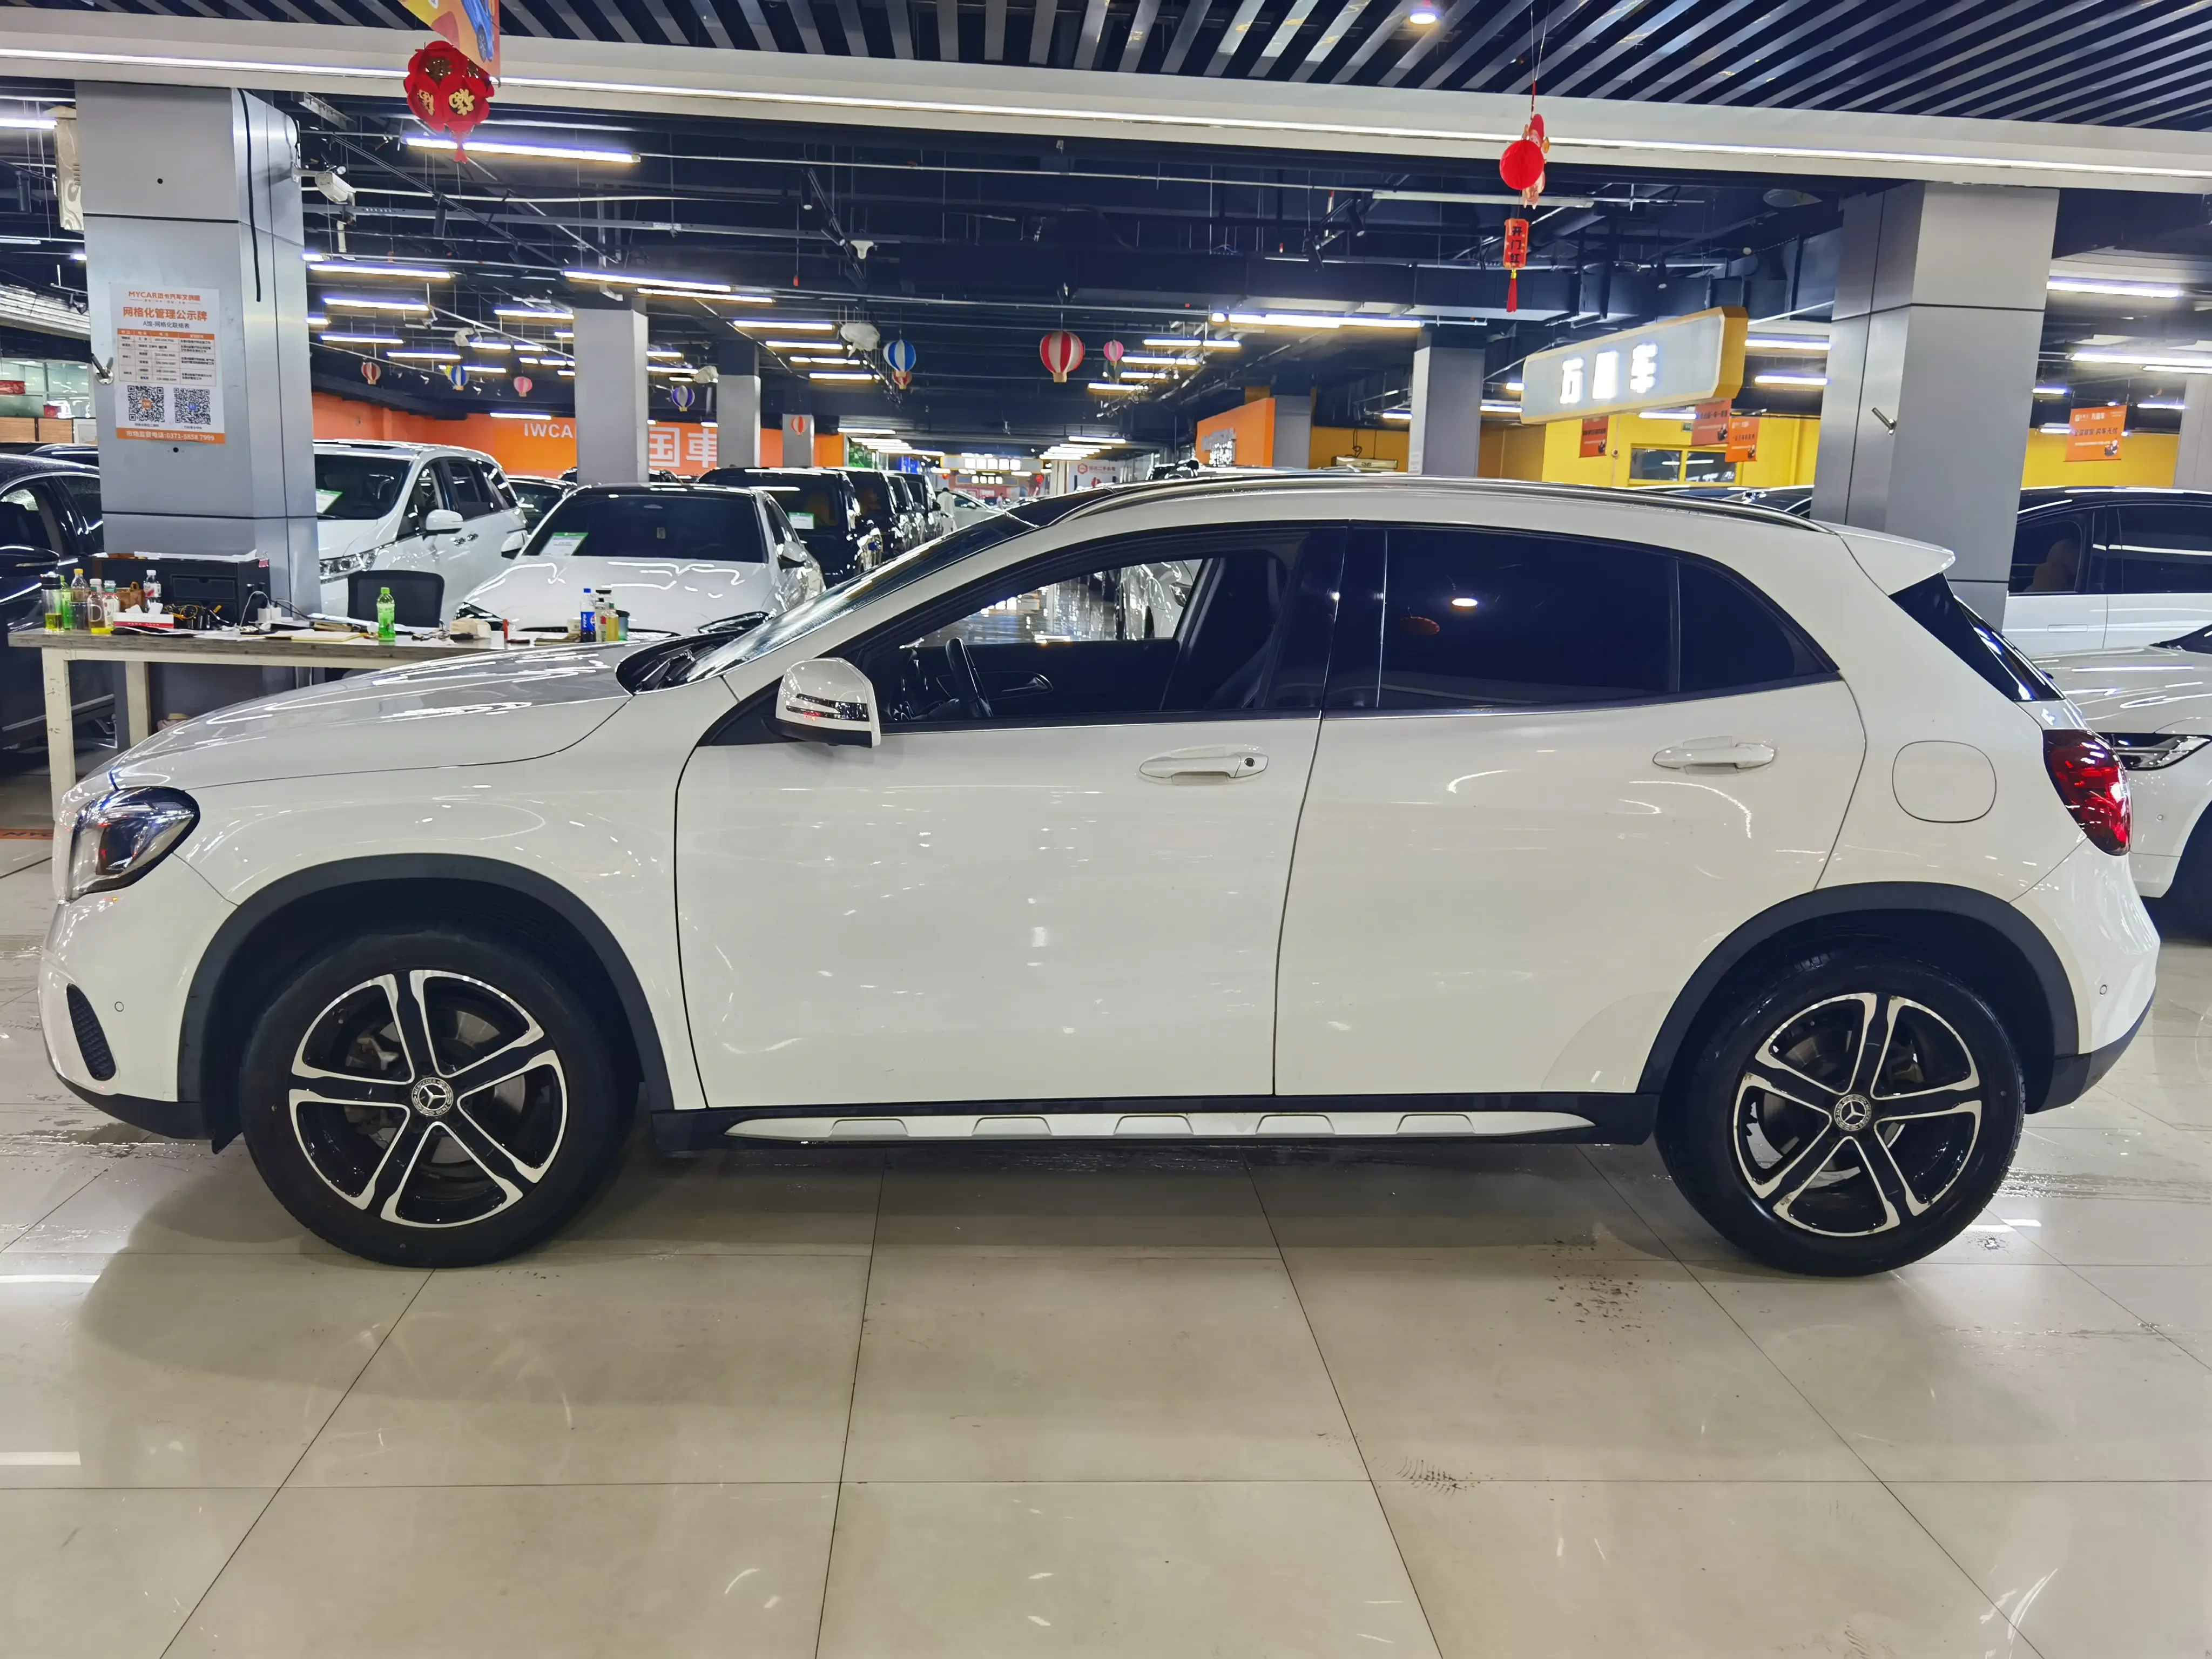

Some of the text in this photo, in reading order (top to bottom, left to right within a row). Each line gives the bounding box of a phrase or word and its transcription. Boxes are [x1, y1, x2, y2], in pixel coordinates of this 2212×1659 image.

[1510, 226, 1522, 264] 开门红
[123, 306, 208, 321] 网格化管理公示牌
[524, 423, 577, 439] IWCA
[436, 1105, 449, 1115] BENZ
